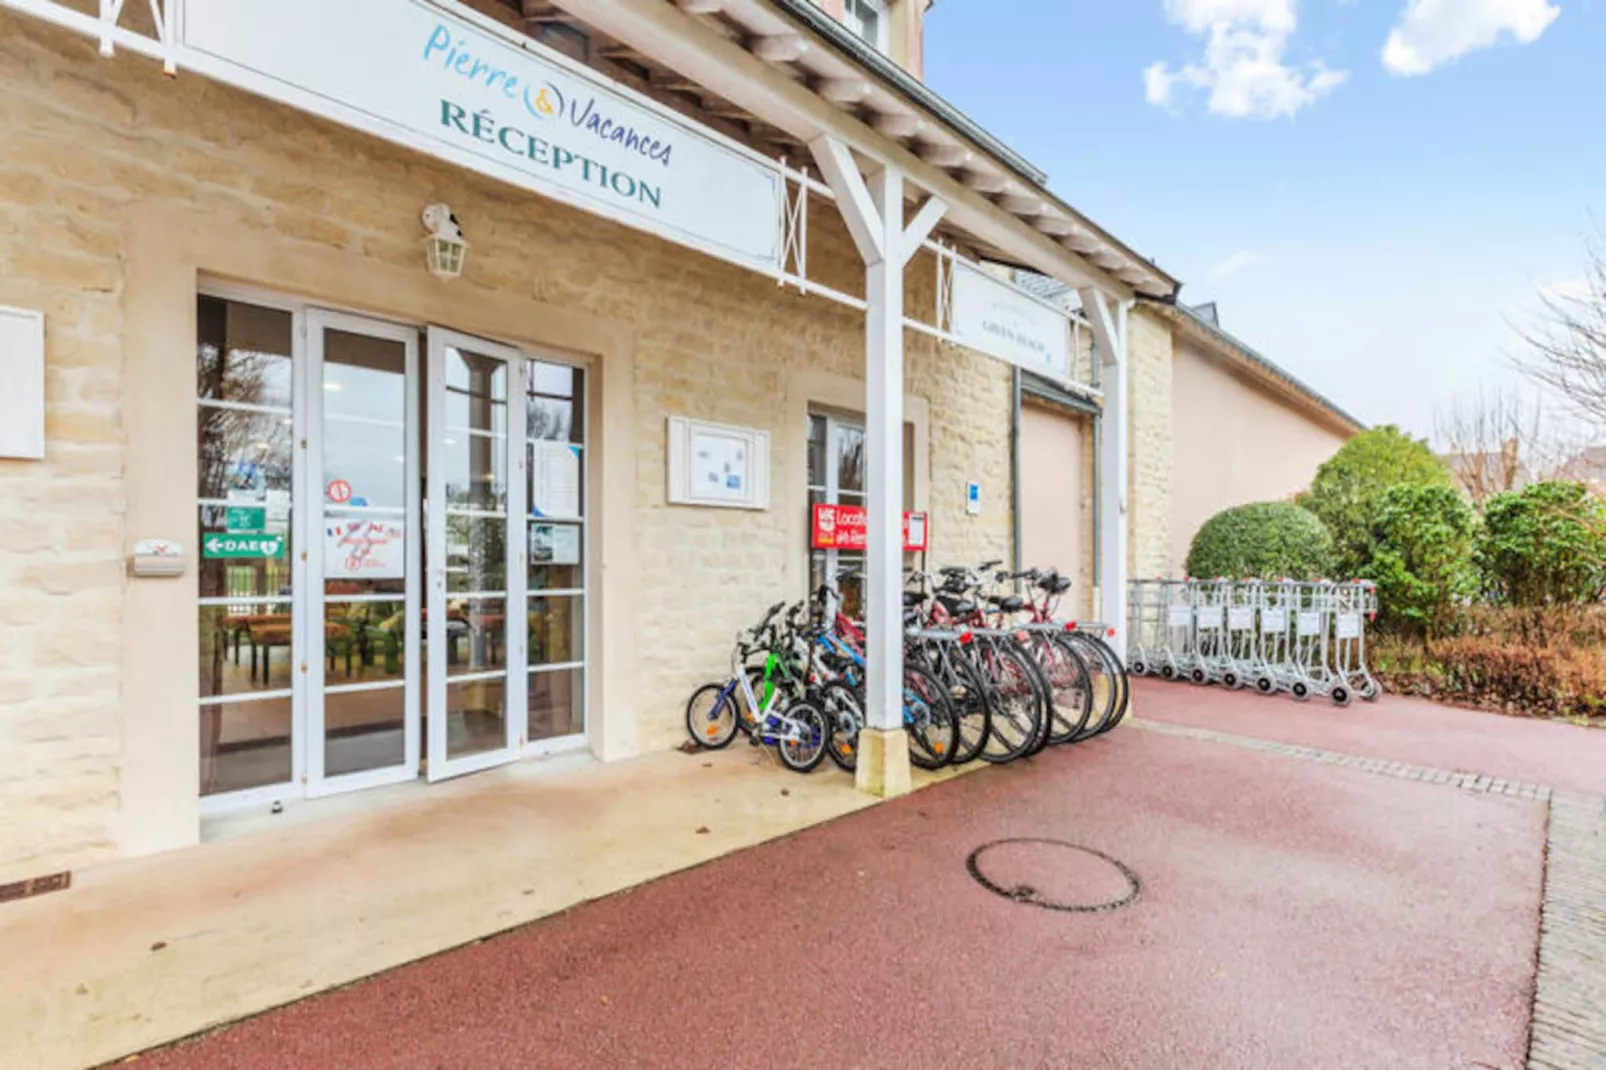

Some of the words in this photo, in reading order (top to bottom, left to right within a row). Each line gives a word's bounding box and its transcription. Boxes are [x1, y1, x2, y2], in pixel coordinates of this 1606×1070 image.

[423, 24, 519, 98] Pierre
[570, 98, 673, 167] Vacances
[440, 99, 662, 208] RÉCEPTION
[224, 540, 259, 552] DAE
